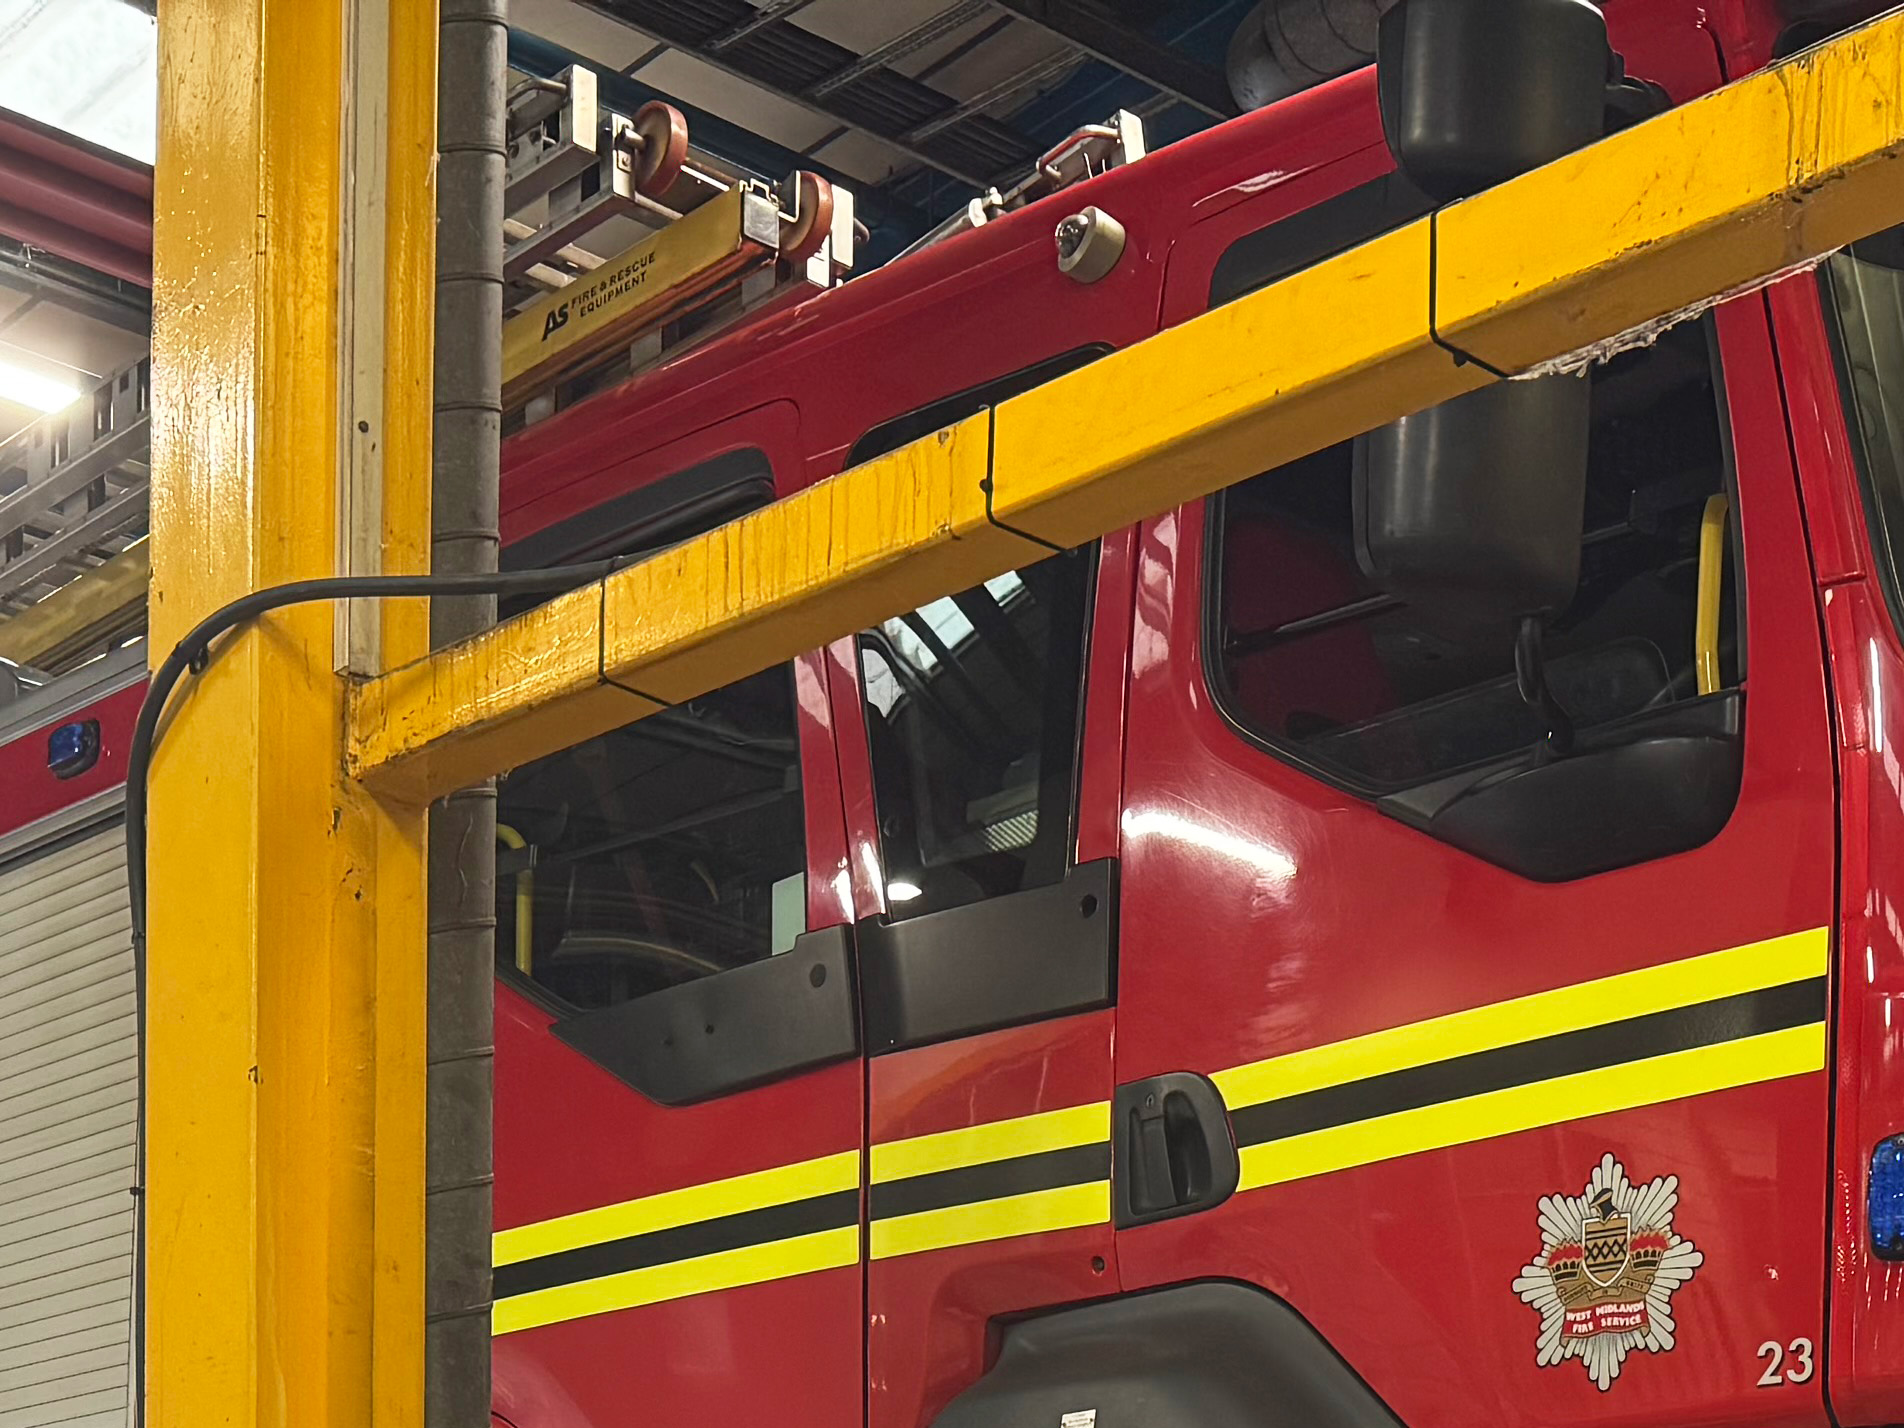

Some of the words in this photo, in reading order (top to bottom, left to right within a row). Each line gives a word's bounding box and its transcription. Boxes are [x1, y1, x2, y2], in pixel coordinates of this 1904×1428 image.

[571, 285, 597, 309] FIRE
[609, 251, 656, 286] RESCUE
[580, 270, 647, 318] EQUIPMENT
[541, 302, 569, 342] AS
[1566, 1310, 1592, 1321] WEST
[1595, 1301, 1645, 1316] MIDLANDS
[1572, 1321, 1594, 1333] FIRE
[1600, 1314, 1642, 1327] SERVICE
[1757, 1337, 1814, 1387] 23
